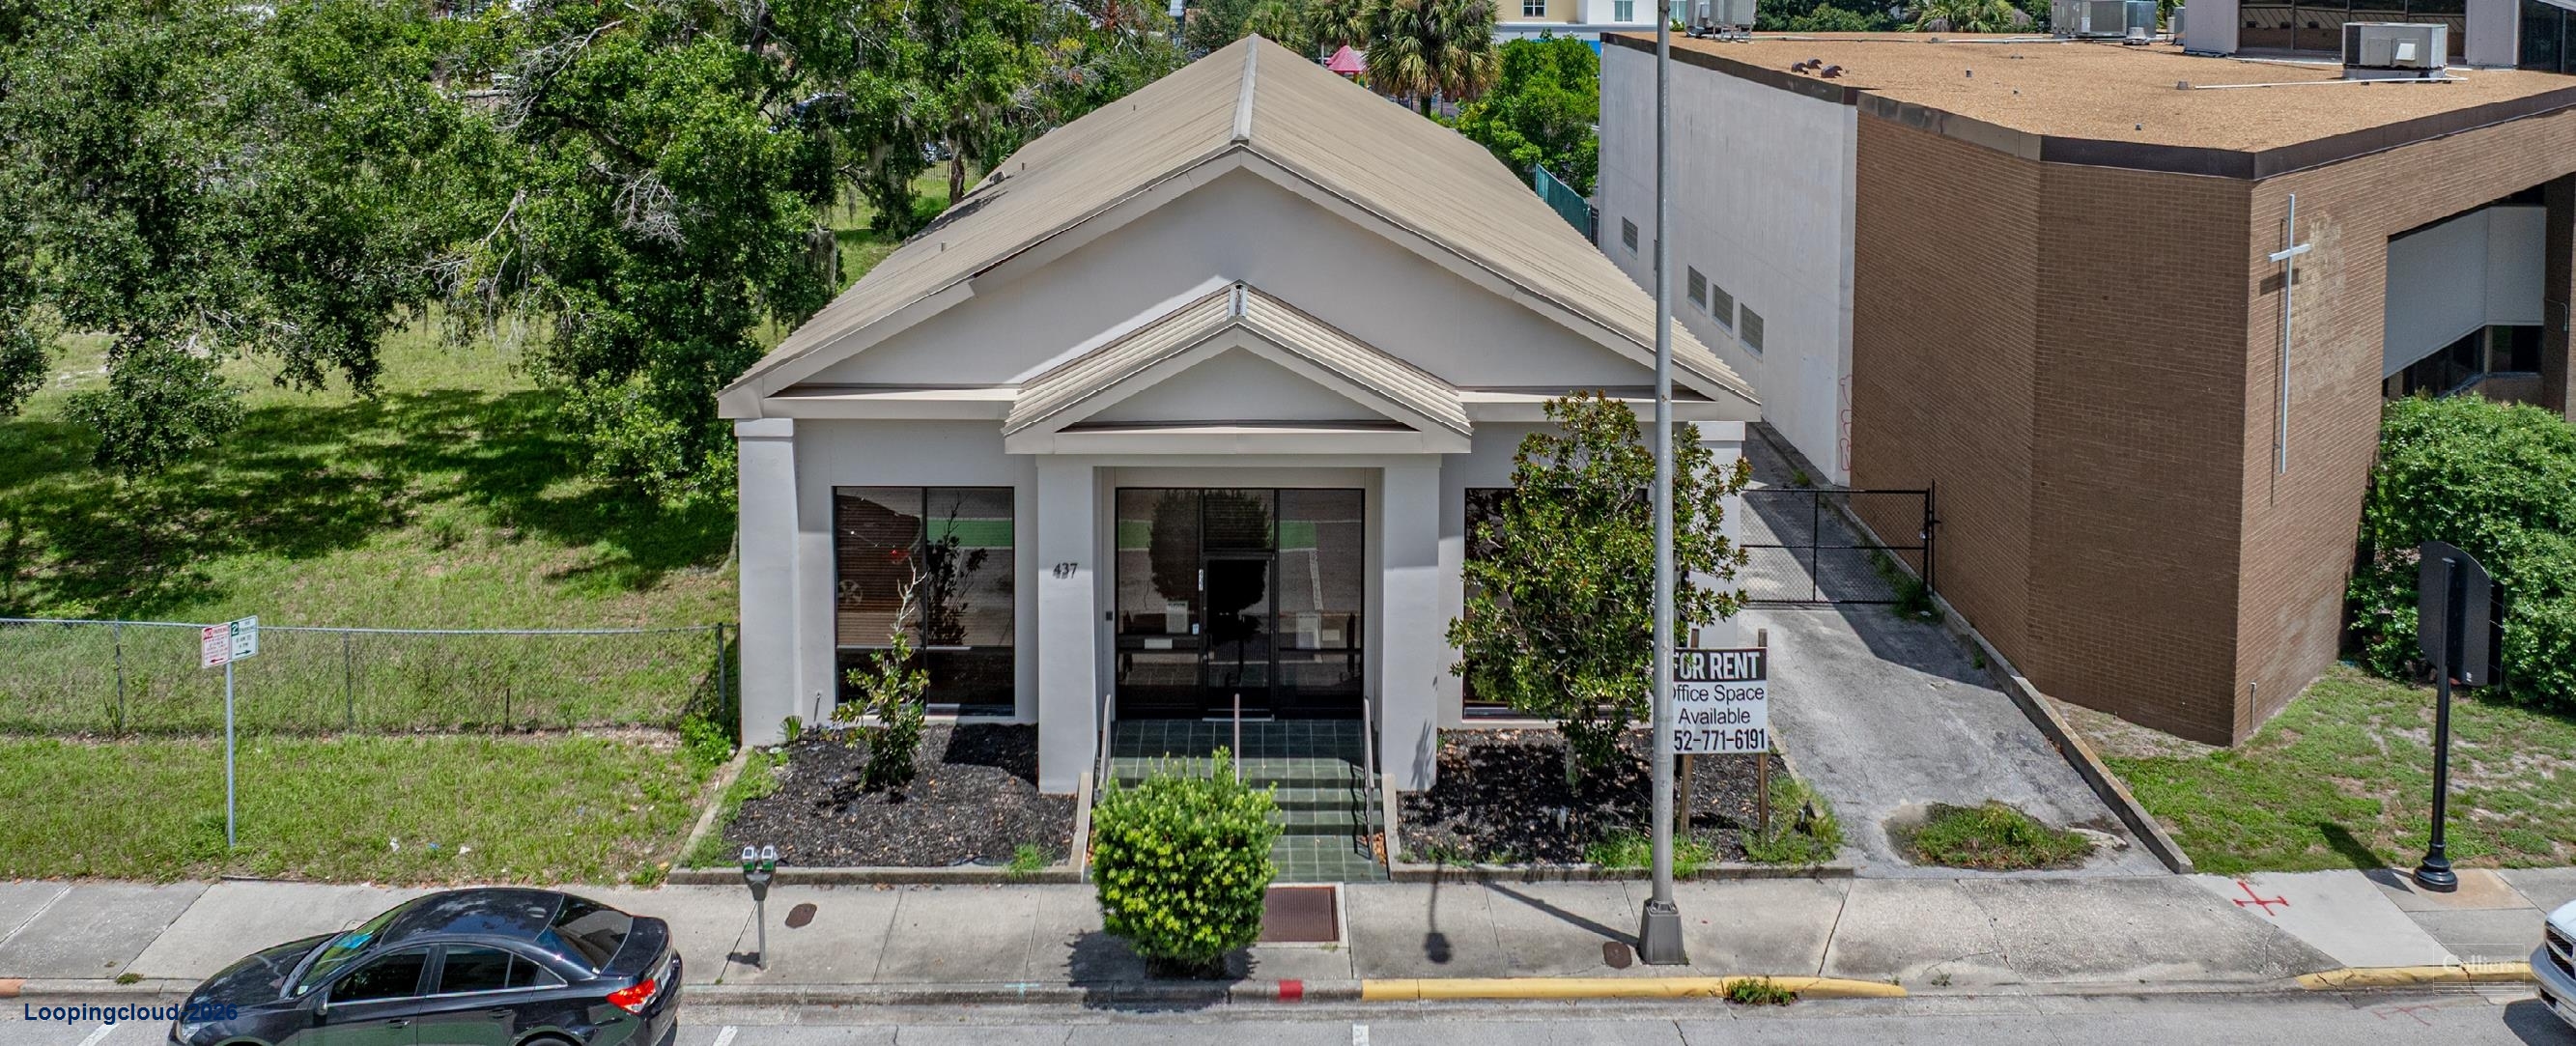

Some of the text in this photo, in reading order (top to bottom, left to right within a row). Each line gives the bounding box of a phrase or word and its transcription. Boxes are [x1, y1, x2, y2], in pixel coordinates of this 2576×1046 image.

[1053, 562, 1078, 578] 437
[232, 623, 239, 635] 2
[1710, 651, 1760, 679] RENT
[1673, 684, 1765, 706] ffice Space
[1678, 707, 1751, 725] Available
[1674, 728, 1765, 750] 52-771-6191
